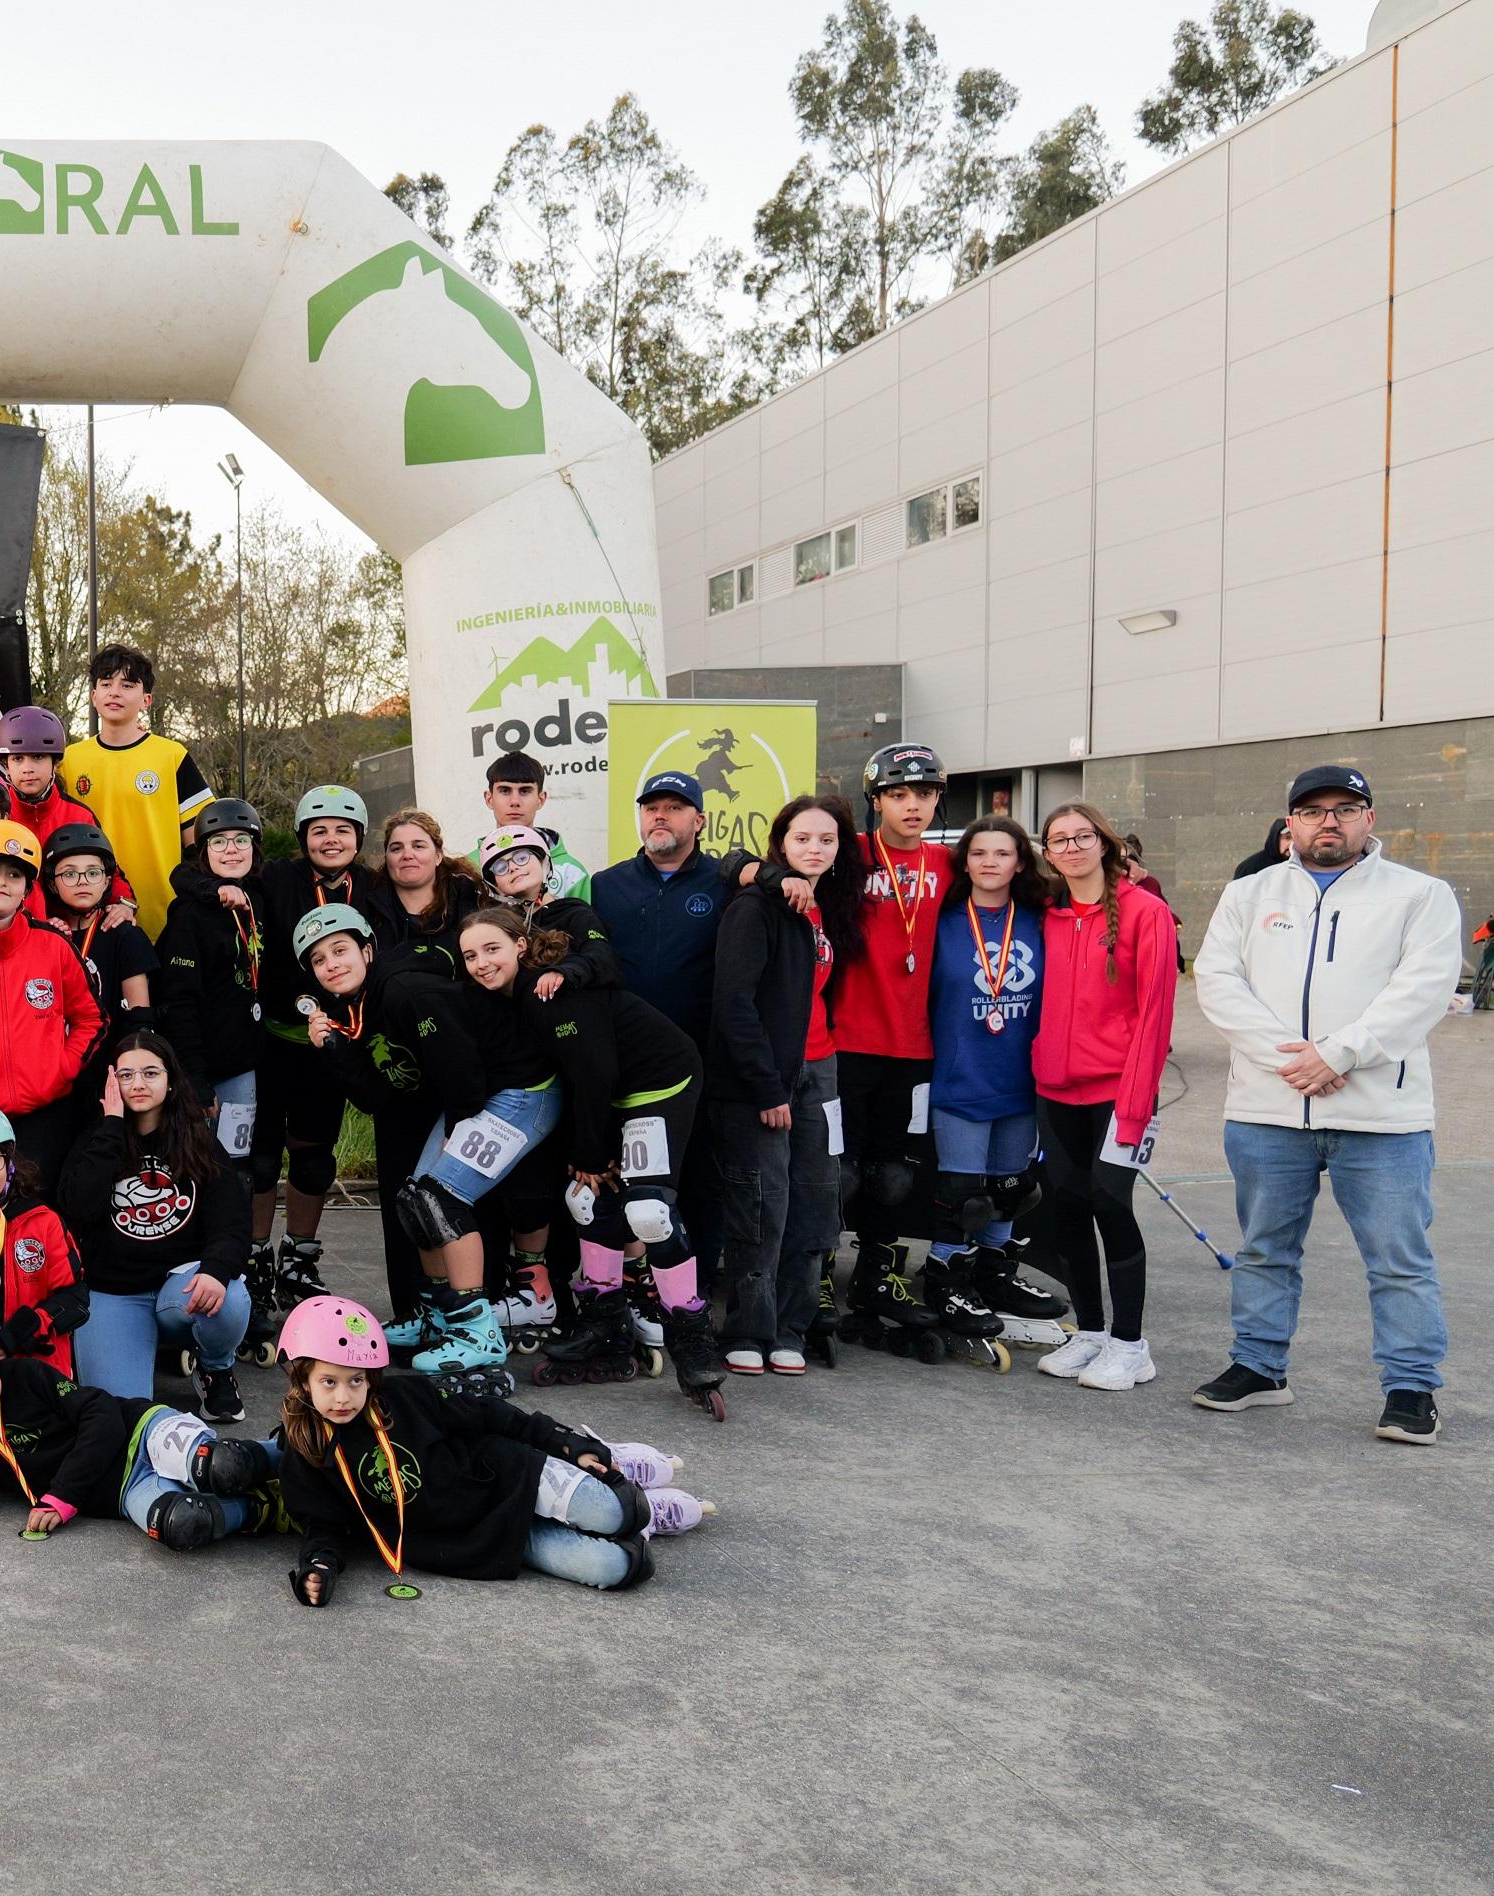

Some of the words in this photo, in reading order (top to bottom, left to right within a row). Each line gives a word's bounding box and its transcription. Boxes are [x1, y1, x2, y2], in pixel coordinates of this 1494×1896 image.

[456, 600, 657, 633] INGENIERÍA&INMOBILIARIA
[471, 698, 608, 758] rode
[1273, 921, 1294, 930] RFEP
[234, 1123, 254, 1150] 8
[460, 1130, 502, 1169] 88
[621, 1140, 648, 1172] 90
